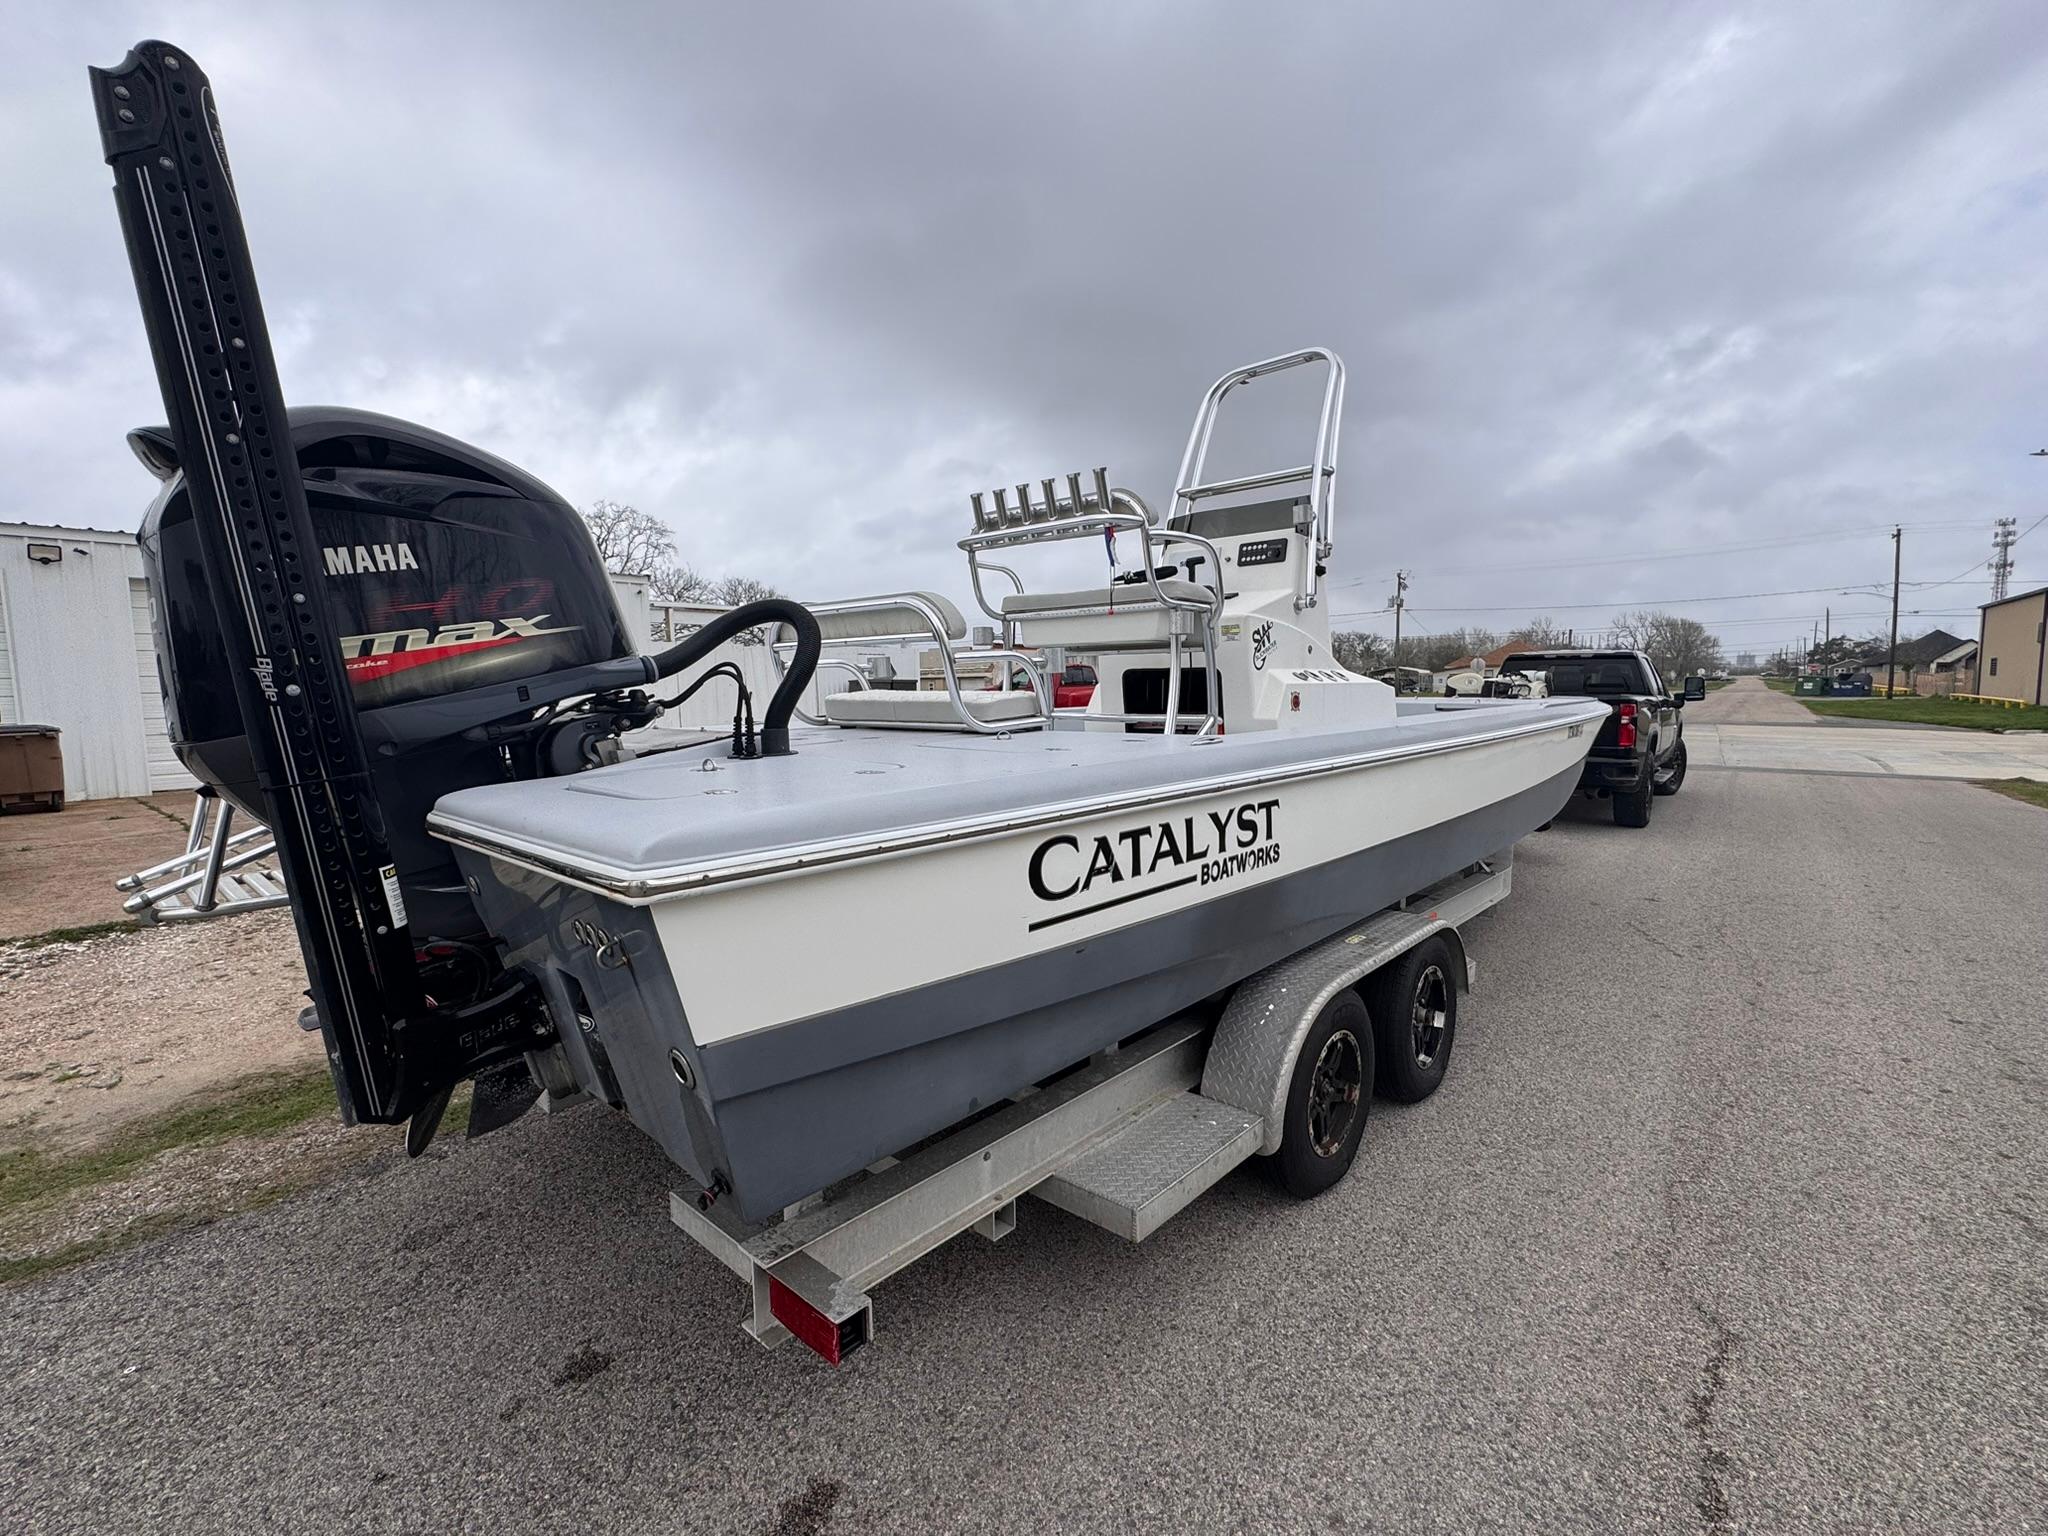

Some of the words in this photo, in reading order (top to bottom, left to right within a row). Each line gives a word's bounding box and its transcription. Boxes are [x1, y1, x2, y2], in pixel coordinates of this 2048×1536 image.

[323, 543, 419, 576] MAHA
[249, 657, 278, 702] Blade
[1028, 799, 1281, 902] CATALYST
[1201, 843, 1281, 886] BOATWORKS
